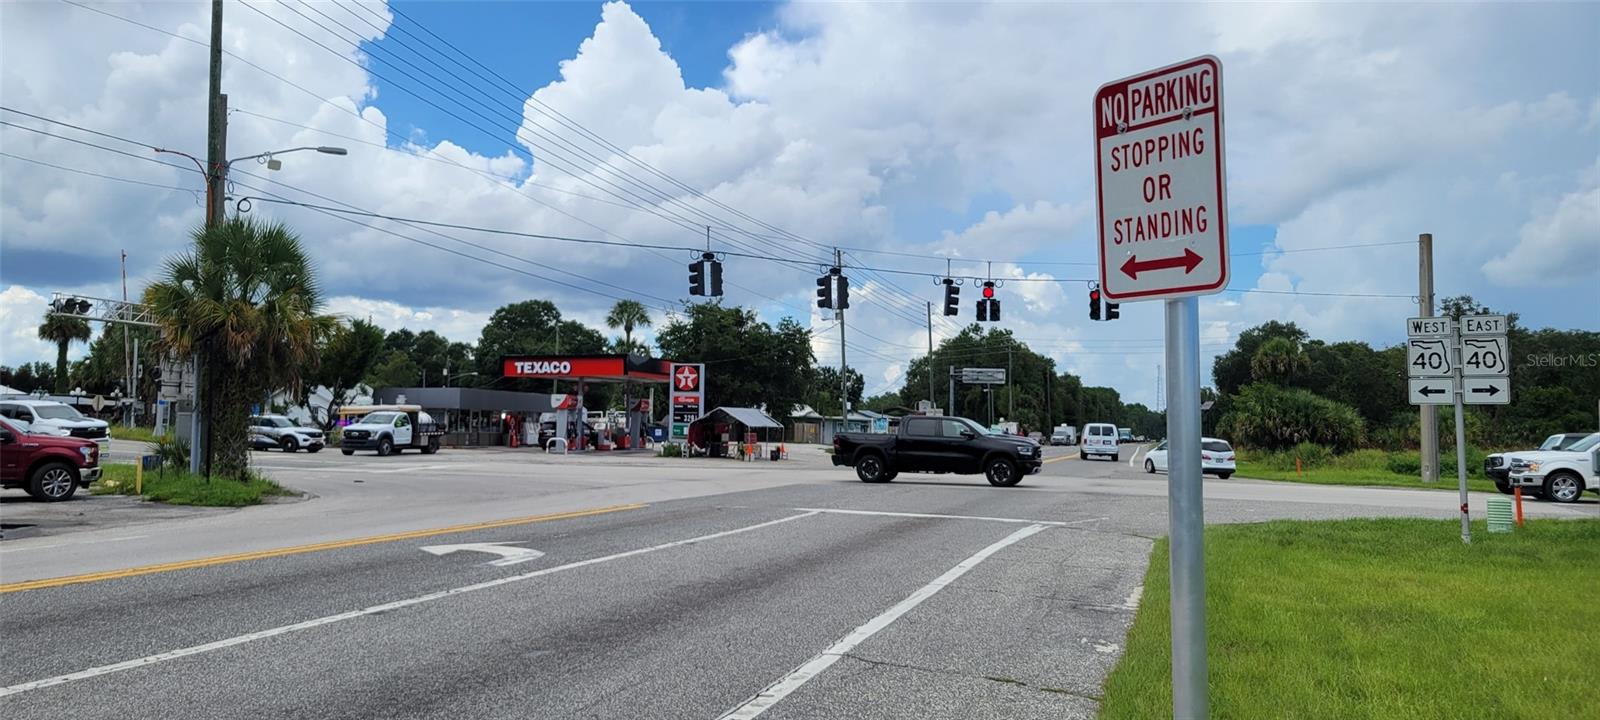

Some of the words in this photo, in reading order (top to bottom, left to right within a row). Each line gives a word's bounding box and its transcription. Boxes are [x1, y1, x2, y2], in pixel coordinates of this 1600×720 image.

[1102, 92, 1125, 128] NO
[1131, 69, 1211, 120] PARKING
[1111, 127, 1204, 172] STOPPING
[1143, 173, 1172, 203] OR
[1114, 205, 1207, 245] STANDING
[1412, 321, 1446, 333] WEST
[1467, 319, 1499, 332] EAST
[514, 361, 571, 374] TEXACO
[1412, 352, 1442, 369] 40
[1466, 351, 1497, 369] 40
